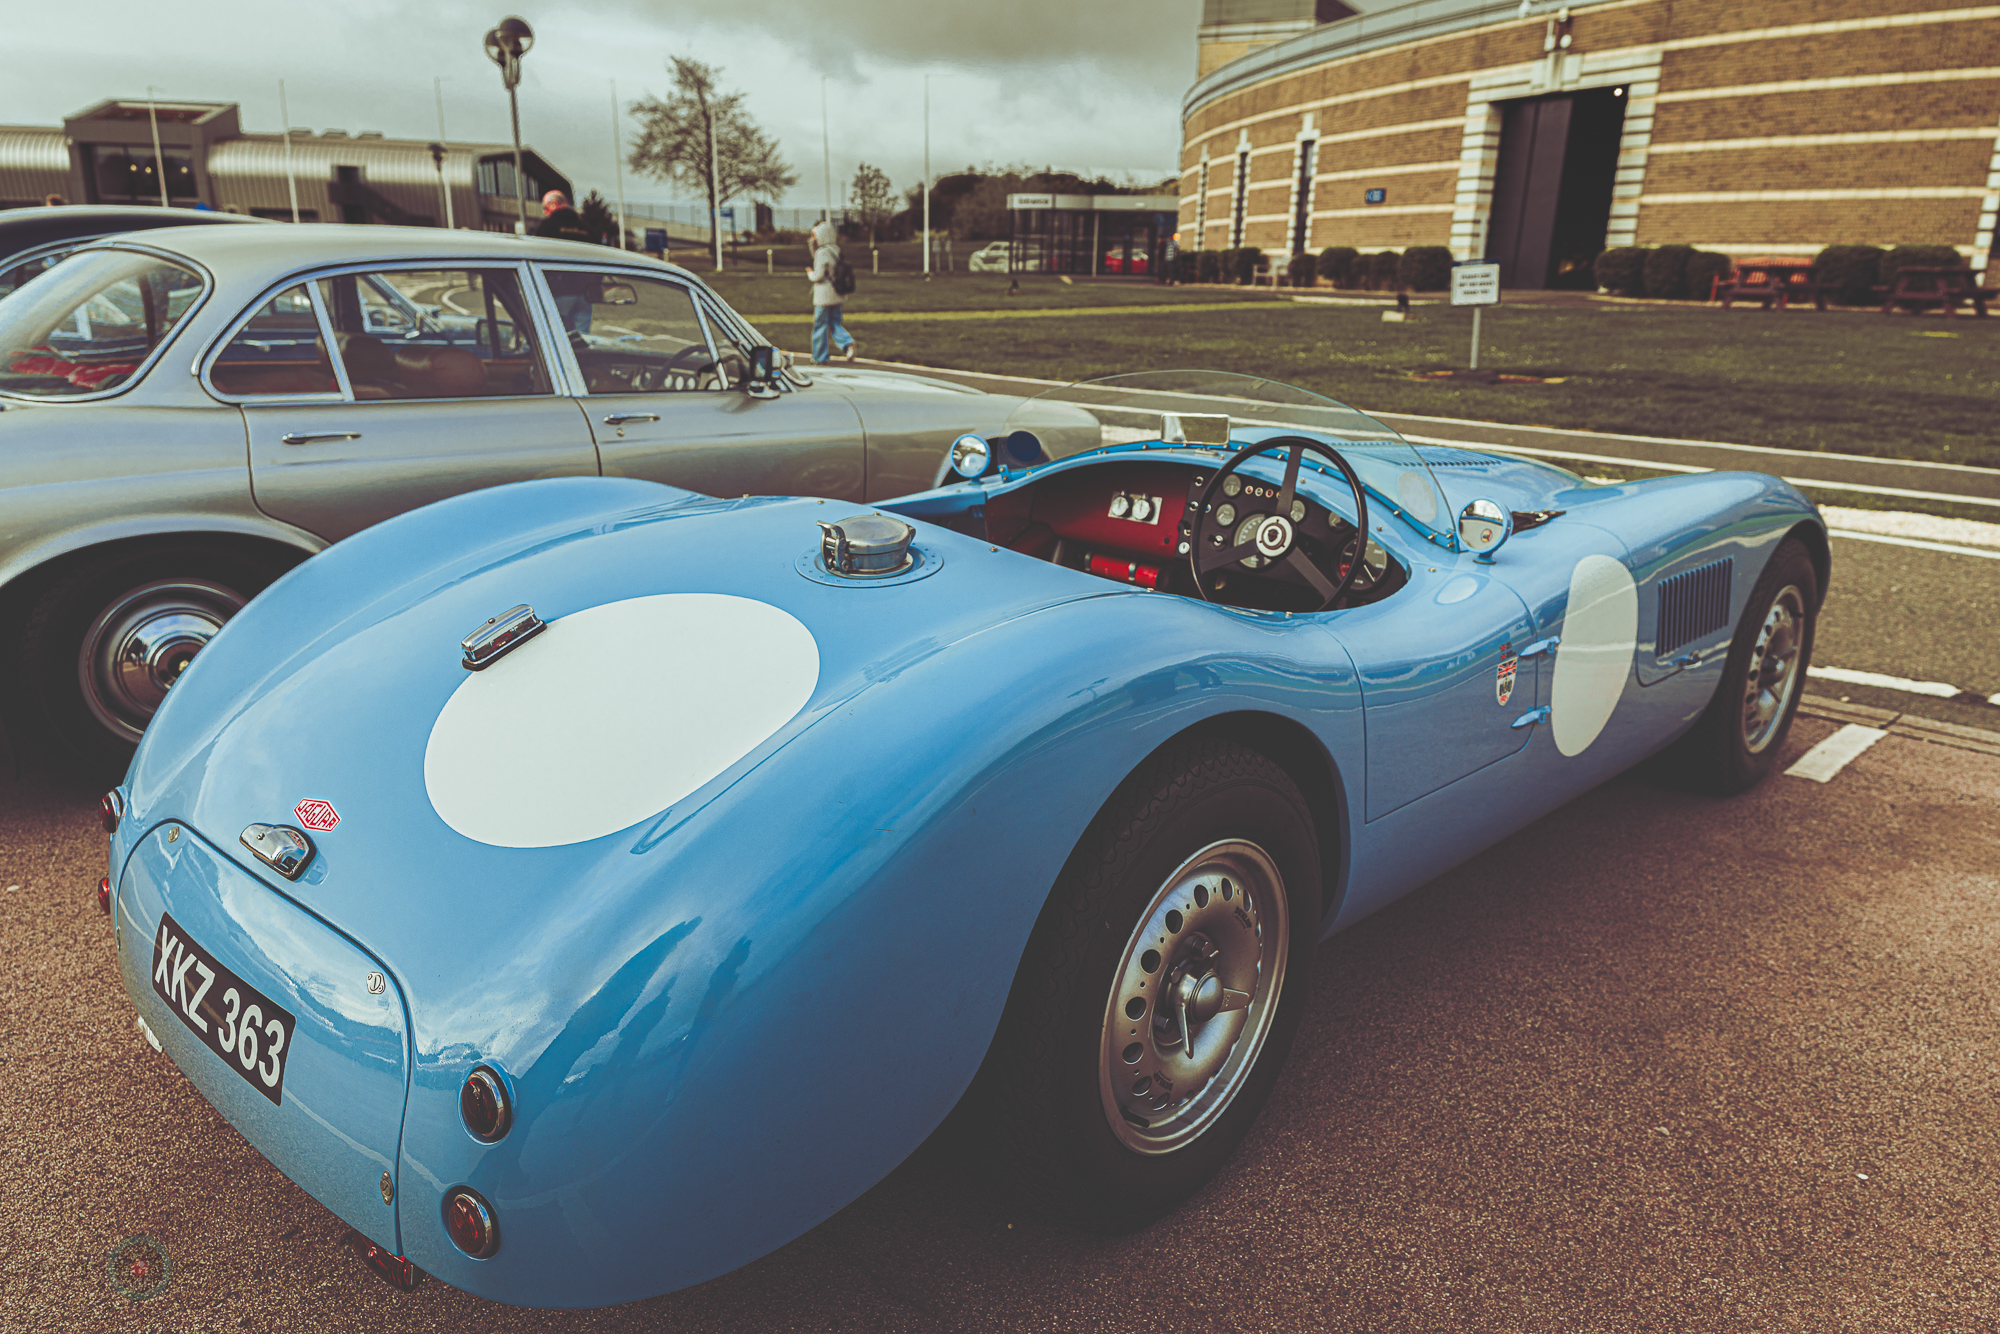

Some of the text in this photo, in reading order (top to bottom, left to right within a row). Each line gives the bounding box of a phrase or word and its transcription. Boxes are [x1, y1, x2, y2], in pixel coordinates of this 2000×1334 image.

[297, 801, 337, 829] JAGUAR
[154, 924, 285, 1088] XKZ 363
